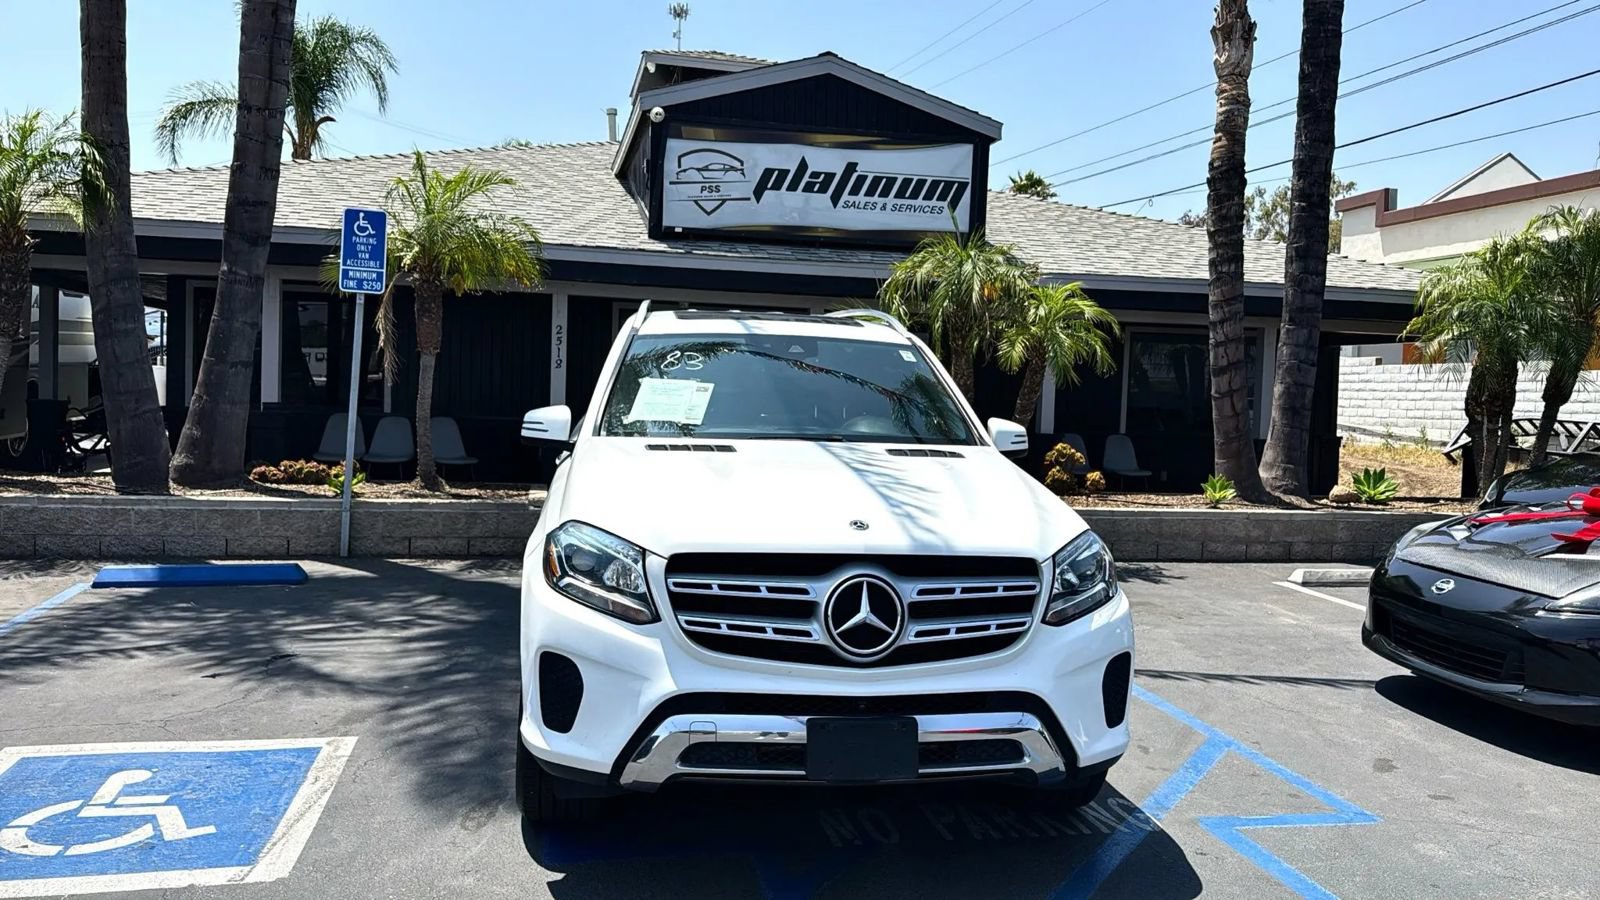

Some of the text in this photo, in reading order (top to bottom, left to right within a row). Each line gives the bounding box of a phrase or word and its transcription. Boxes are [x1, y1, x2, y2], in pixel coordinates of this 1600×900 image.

[700, 185, 721, 194] PSS
[842, 200, 944, 215] SALES & SERVICES
[352, 236, 377, 245] PARKING
[347, 259, 380, 268] ACCESSIBLE
[348, 270, 377, 280] MINIMUM
[343, 279, 358, 289] FINE
[661, 350, 704, 371] 83
[818, 807, 899, 846] NO
